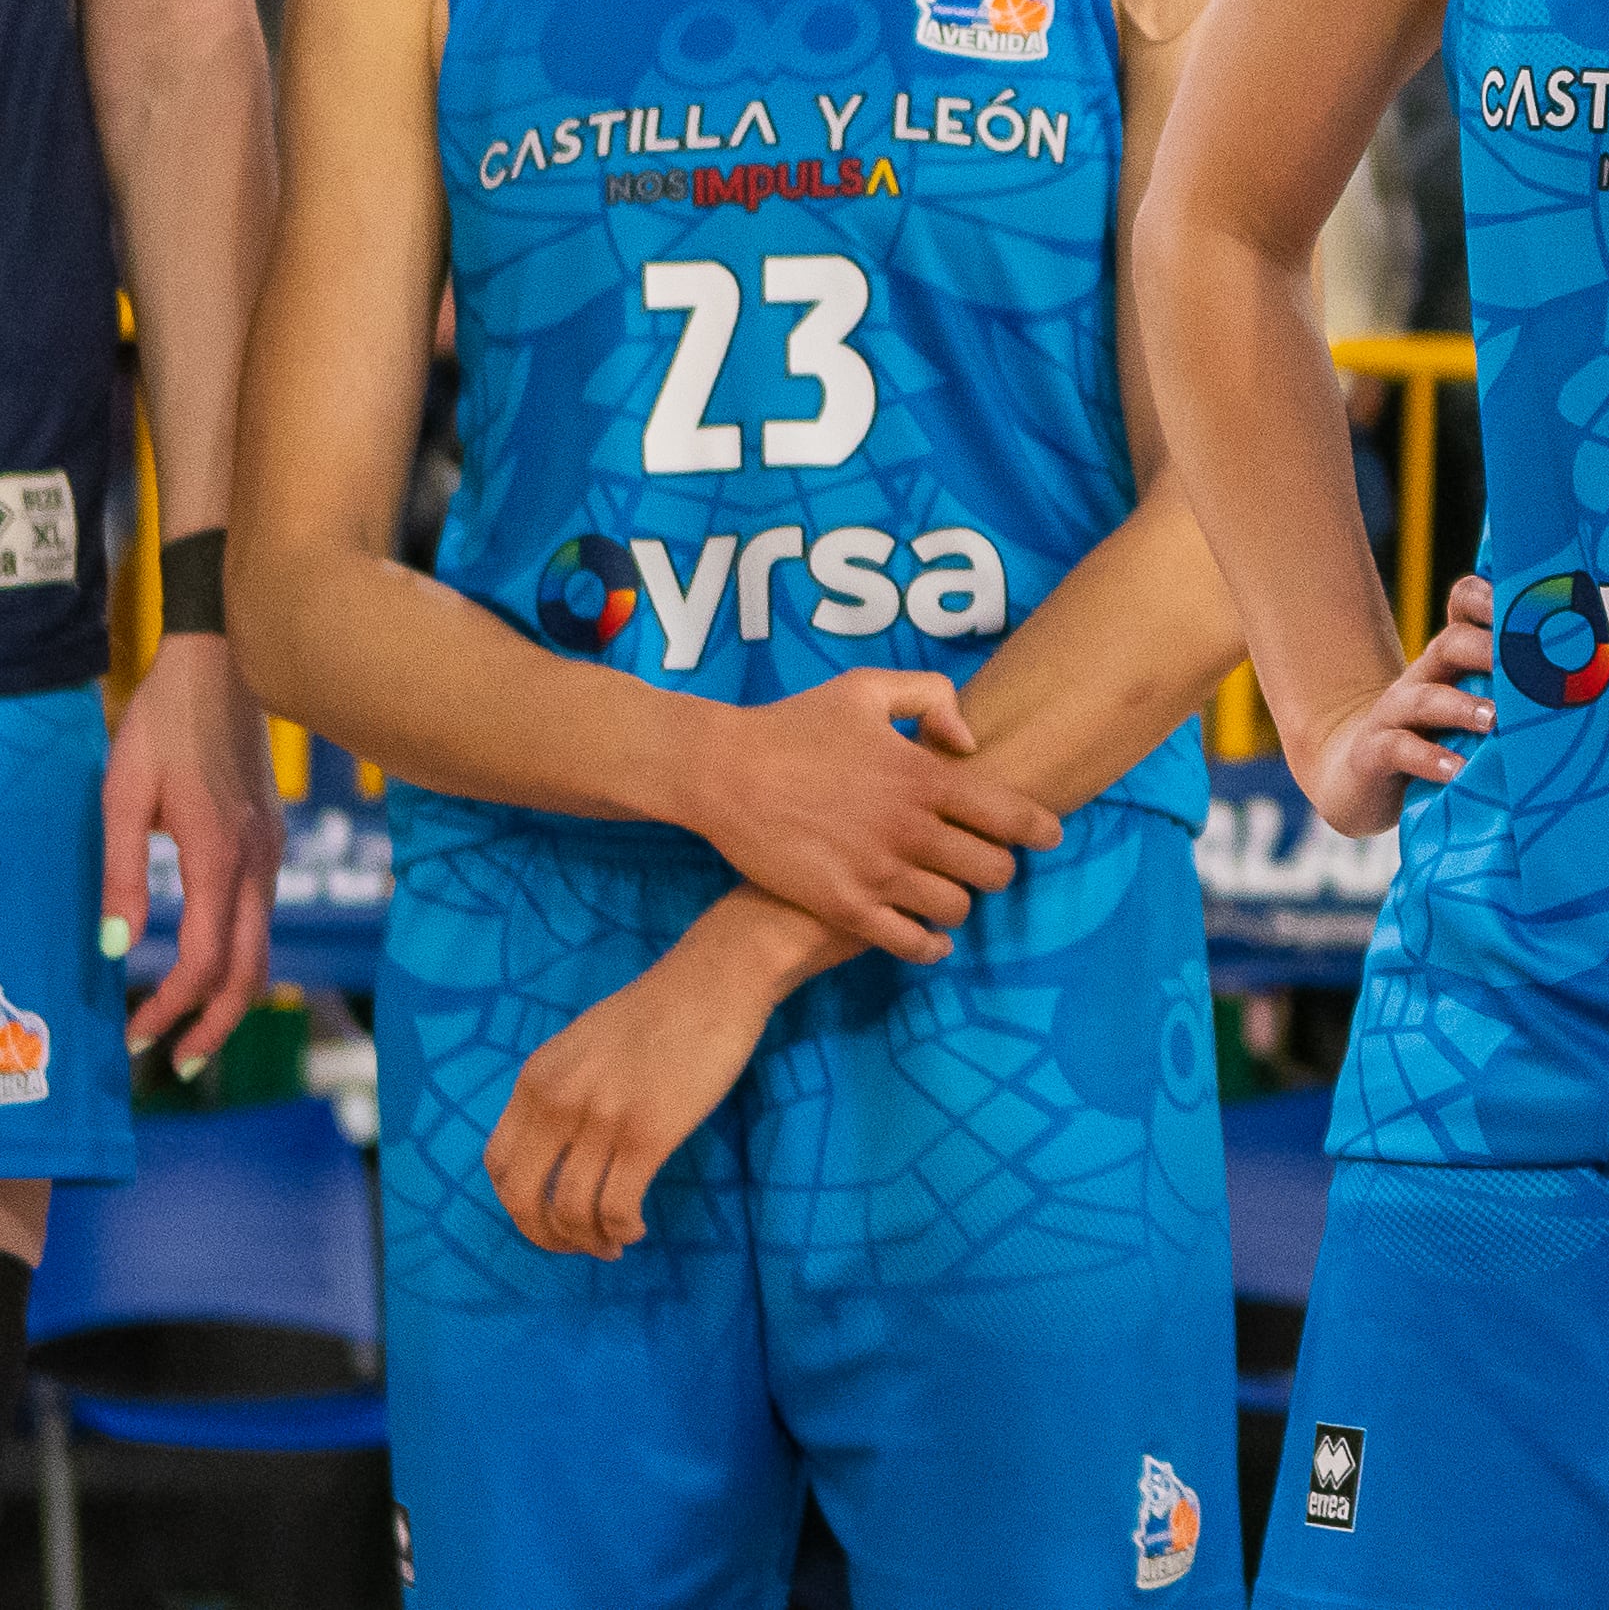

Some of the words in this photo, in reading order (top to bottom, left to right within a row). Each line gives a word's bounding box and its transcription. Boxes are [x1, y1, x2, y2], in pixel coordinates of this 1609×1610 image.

[926, 21, 1043, 54] AVENIDA
[479, 101, 777, 189] CASTILLA
[818, 93, 864, 152] Y
[893, 89, 1069, 163] LEÓN
[643, 254, 877, 474] 23
